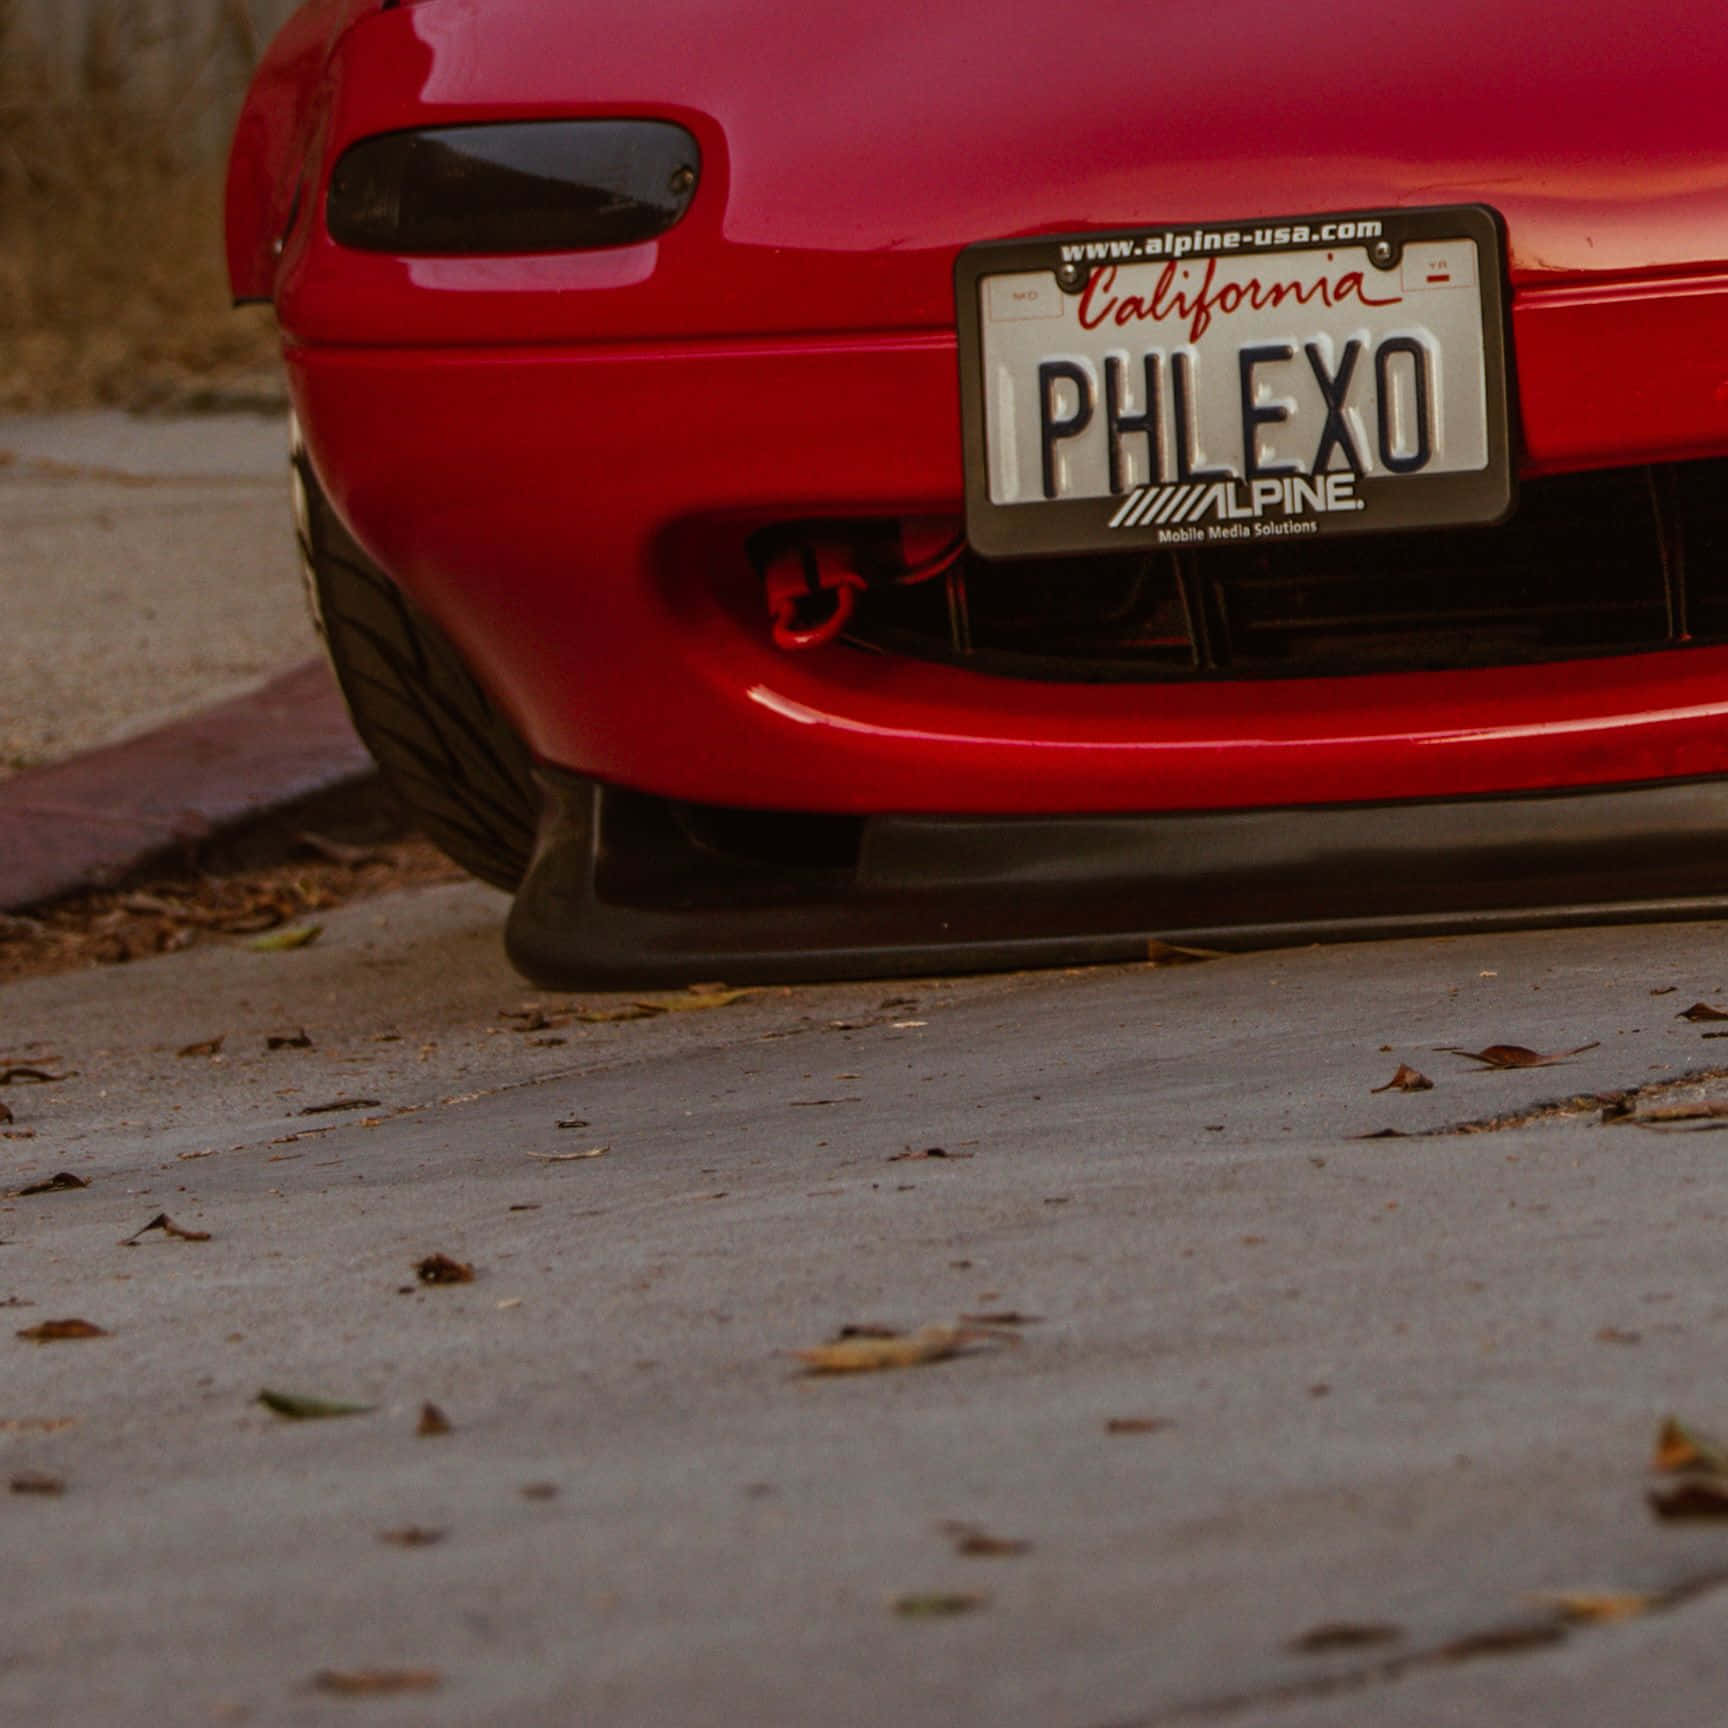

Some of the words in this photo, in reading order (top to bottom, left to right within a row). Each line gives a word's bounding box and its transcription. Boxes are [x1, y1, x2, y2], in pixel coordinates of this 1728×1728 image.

[1061, 219, 1383, 263] www.alpine-usa.com
[1078, 251, 1403, 343] California
[1037, 335, 1436, 498] PHLEXO
[1183, 472, 1359, 522] ALPINE
[1158, 527, 1204, 543] Mobile
[1208, 523, 1251, 540] Media
[1255, 519, 1318, 536] Solutions
